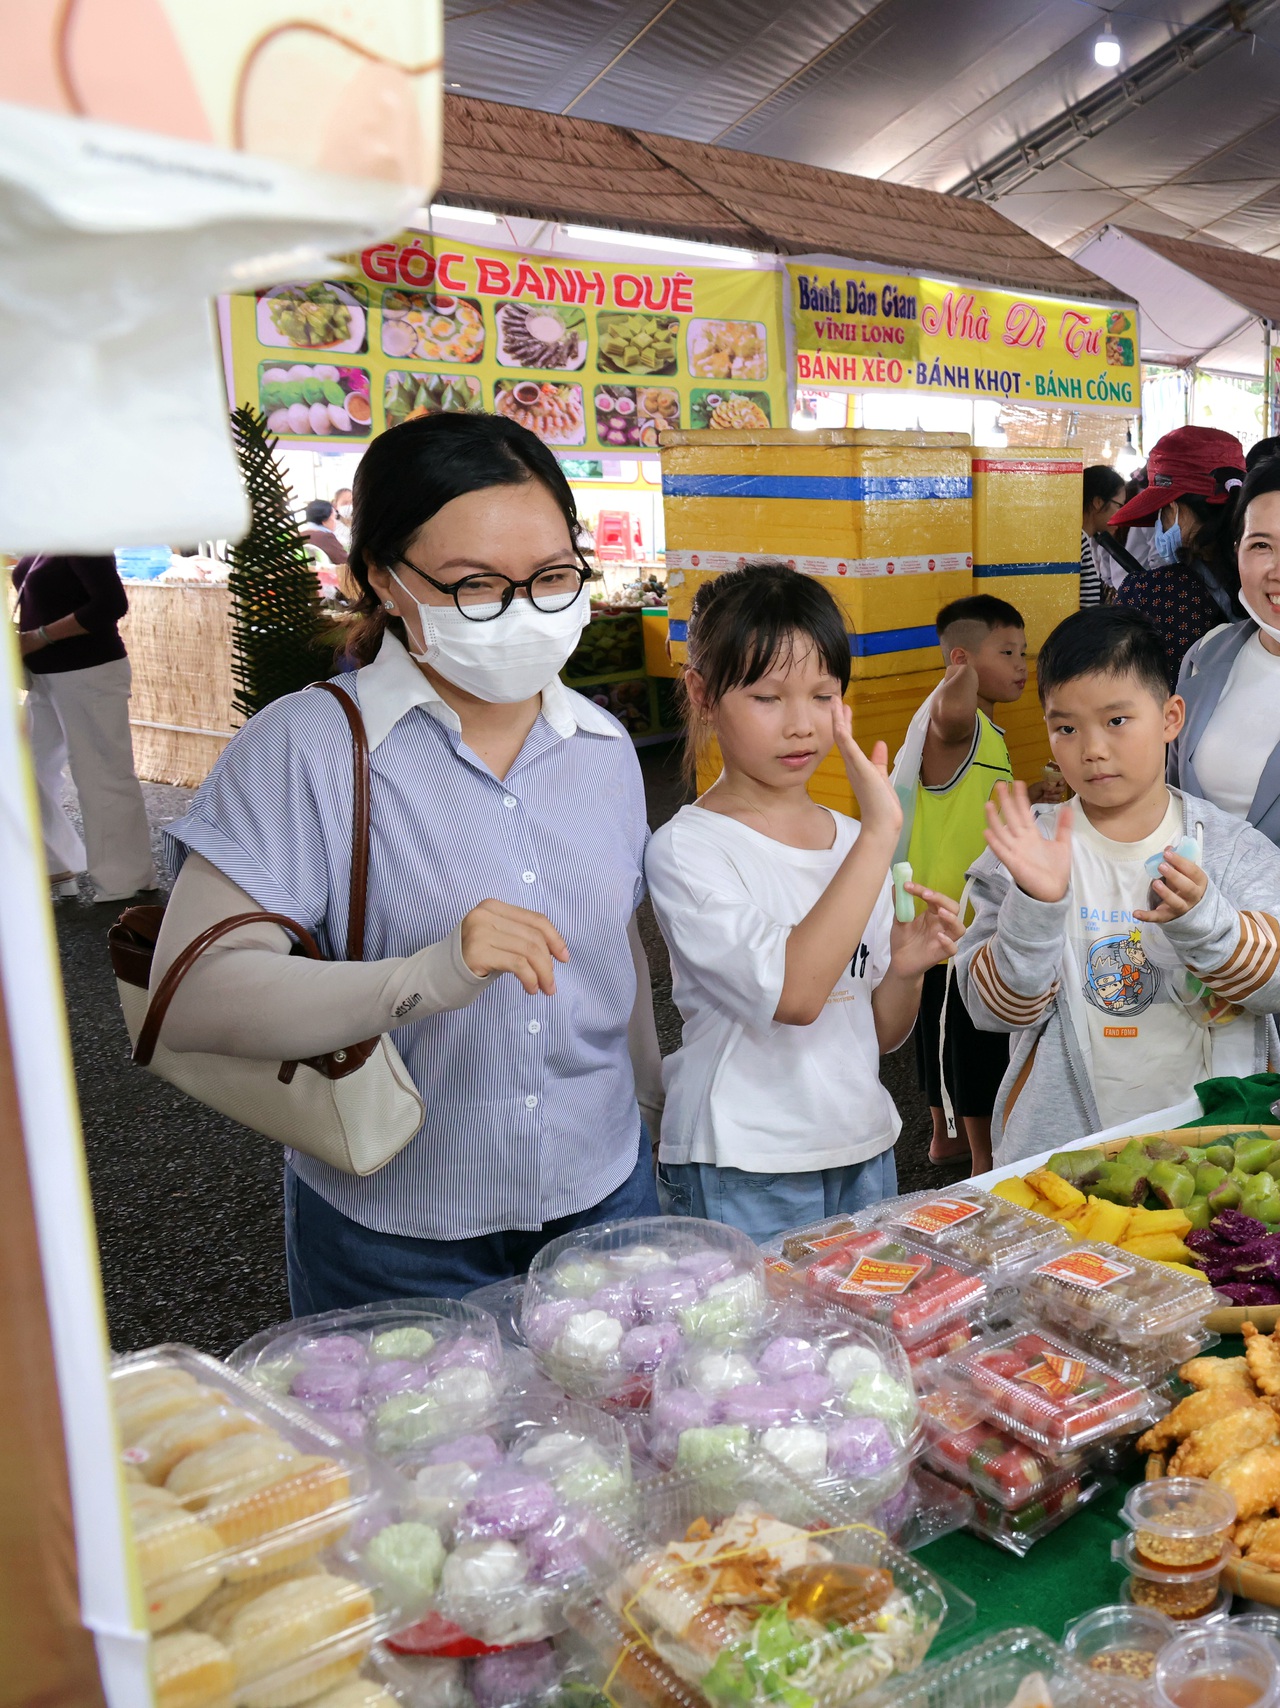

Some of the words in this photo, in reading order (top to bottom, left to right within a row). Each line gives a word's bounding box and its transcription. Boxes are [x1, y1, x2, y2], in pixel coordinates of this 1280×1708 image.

[474, 256, 605, 305] BÁNH
[613, 271, 694, 313] QUÊ
[797, 274, 841, 313] Bánh
[846, 279, 877, 316] Dân
[882, 283, 917, 319] Gian
[814, 316, 857, 341] VĨNH
[861, 324, 905, 345] LONG
[921, 290, 990, 341] Nhà
[1003, 302, 1046, 349] Dì
[797, 348, 856, 381] BÁNH
[862, 352, 903, 383] XÈO
[916, 357, 969, 388] BÁNH
[974, 368, 1021, 398] KHỌT
[1035, 370, 1082, 398] BÁNH
[1086, 371, 1132, 403] CỐNG
